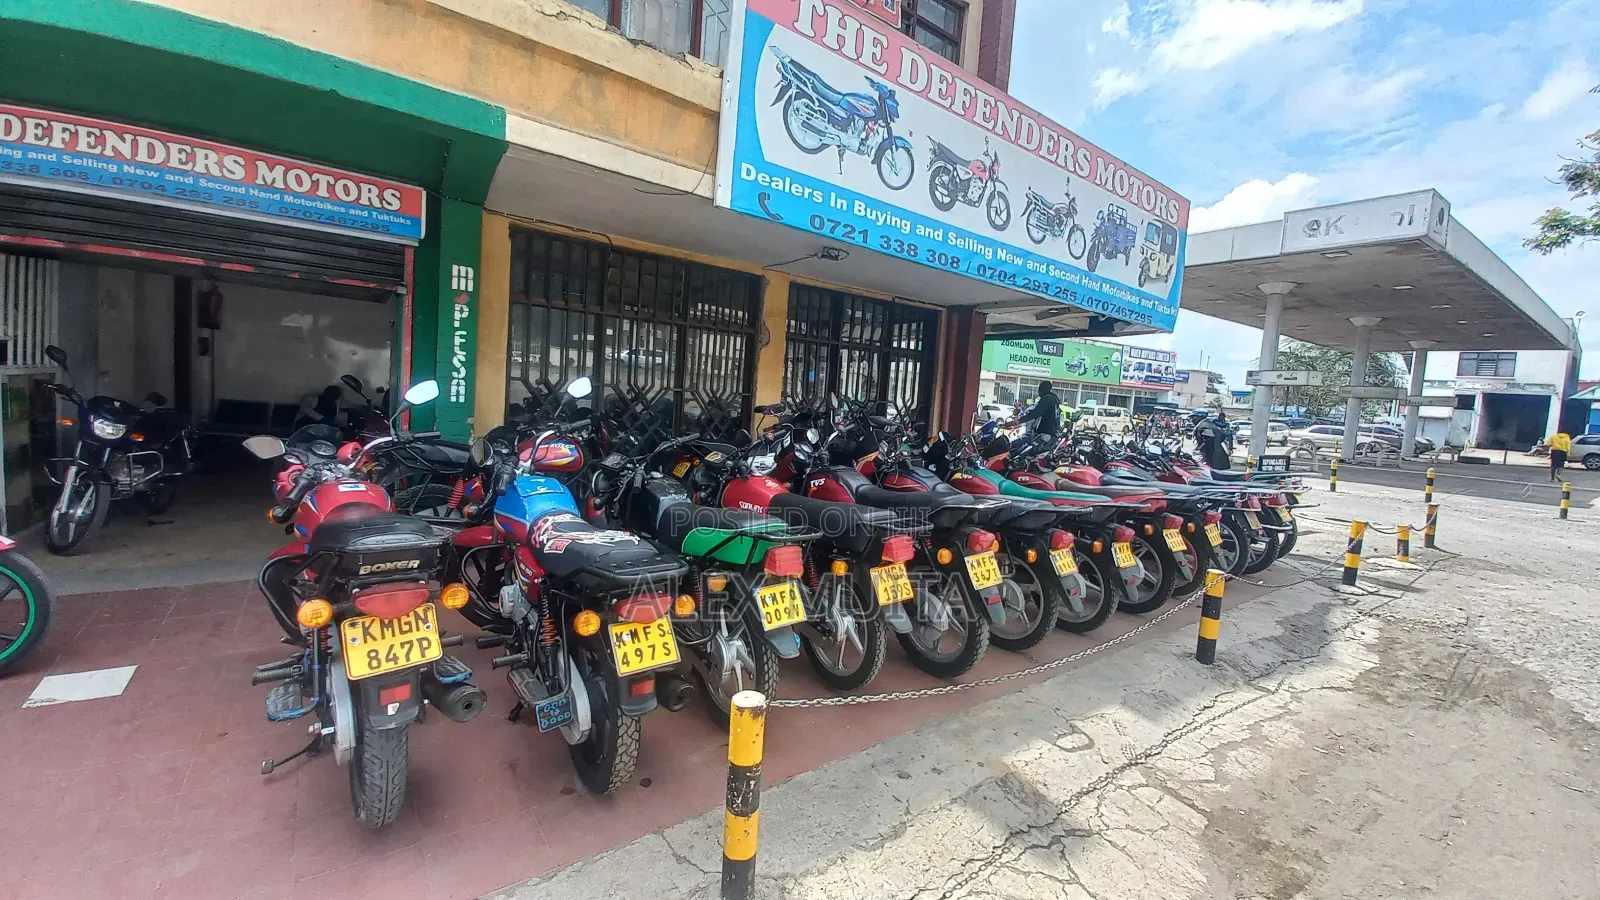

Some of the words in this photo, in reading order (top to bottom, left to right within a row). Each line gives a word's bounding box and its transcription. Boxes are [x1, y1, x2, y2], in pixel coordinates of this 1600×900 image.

[793, 0, 889, 76] THE
[897, 45, 1091, 178] DEFENDERS
[1095, 156, 1180, 225] MOTORS
[0, 113, 247, 181] DEFENDERS
[254, 159, 402, 212] MOTORS
[27, 150, 57, 163] and
[62, 155, 118, 173] Selling
[123, 164, 160, 178] New
[164, 172, 194, 185] and
[199, 175, 246, 195] Second
[250, 188, 281, 202] Hand
[284, 194, 346, 214] Motorbikes
[349, 207, 369, 218] and
[371, 211, 412, 227] Tuktuks
[49, 167, 90, 181] 308
[112, 176, 167, 193] 0704
[222, 195, 260, 210] 255
[278, 205, 392, 233] 0707467295
[740, 161, 824, 203] Dealers
[829, 191, 848, 212] In
[853, 200, 912, 235] Buying
[915, 222, 943, 242] and
[947, 231, 993, 259] Selling
[997, 246, 1023, 267] New
[1027, 260, 1047, 275] and
[1048, 264, 1081, 285] Second
[1082, 275, 1101, 292] Hand
[1102, 282, 1140, 305] Motorbikes
[1140, 297, 1154, 310] and
[809, 214, 869, 244] 0721
[879, 234, 919, 259] 338
[925, 247, 961, 271] 308
[976, 263, 1017, 286] 0704
[1022, 276, 1049, 295] 293
[1054, 284, 1078, 303] 255
[1009, 354, 1028, 363] HEAD
[1028, 357, 1051, 366] OFFICE
[1042, 344, 1057, 354] NSI
[810, 478, 826, 488] TVS
[358, 559, 421, 576] BOXER
[884, 582, 911, 601] 159S
[361, 609, 430, 644] KMGN
[615, 623, 667, 650] KMFS
[366, 637, 432, 671] 847P
[621, 642, 672, 668] 497S
[541, 711, 571, 729] GOOD
